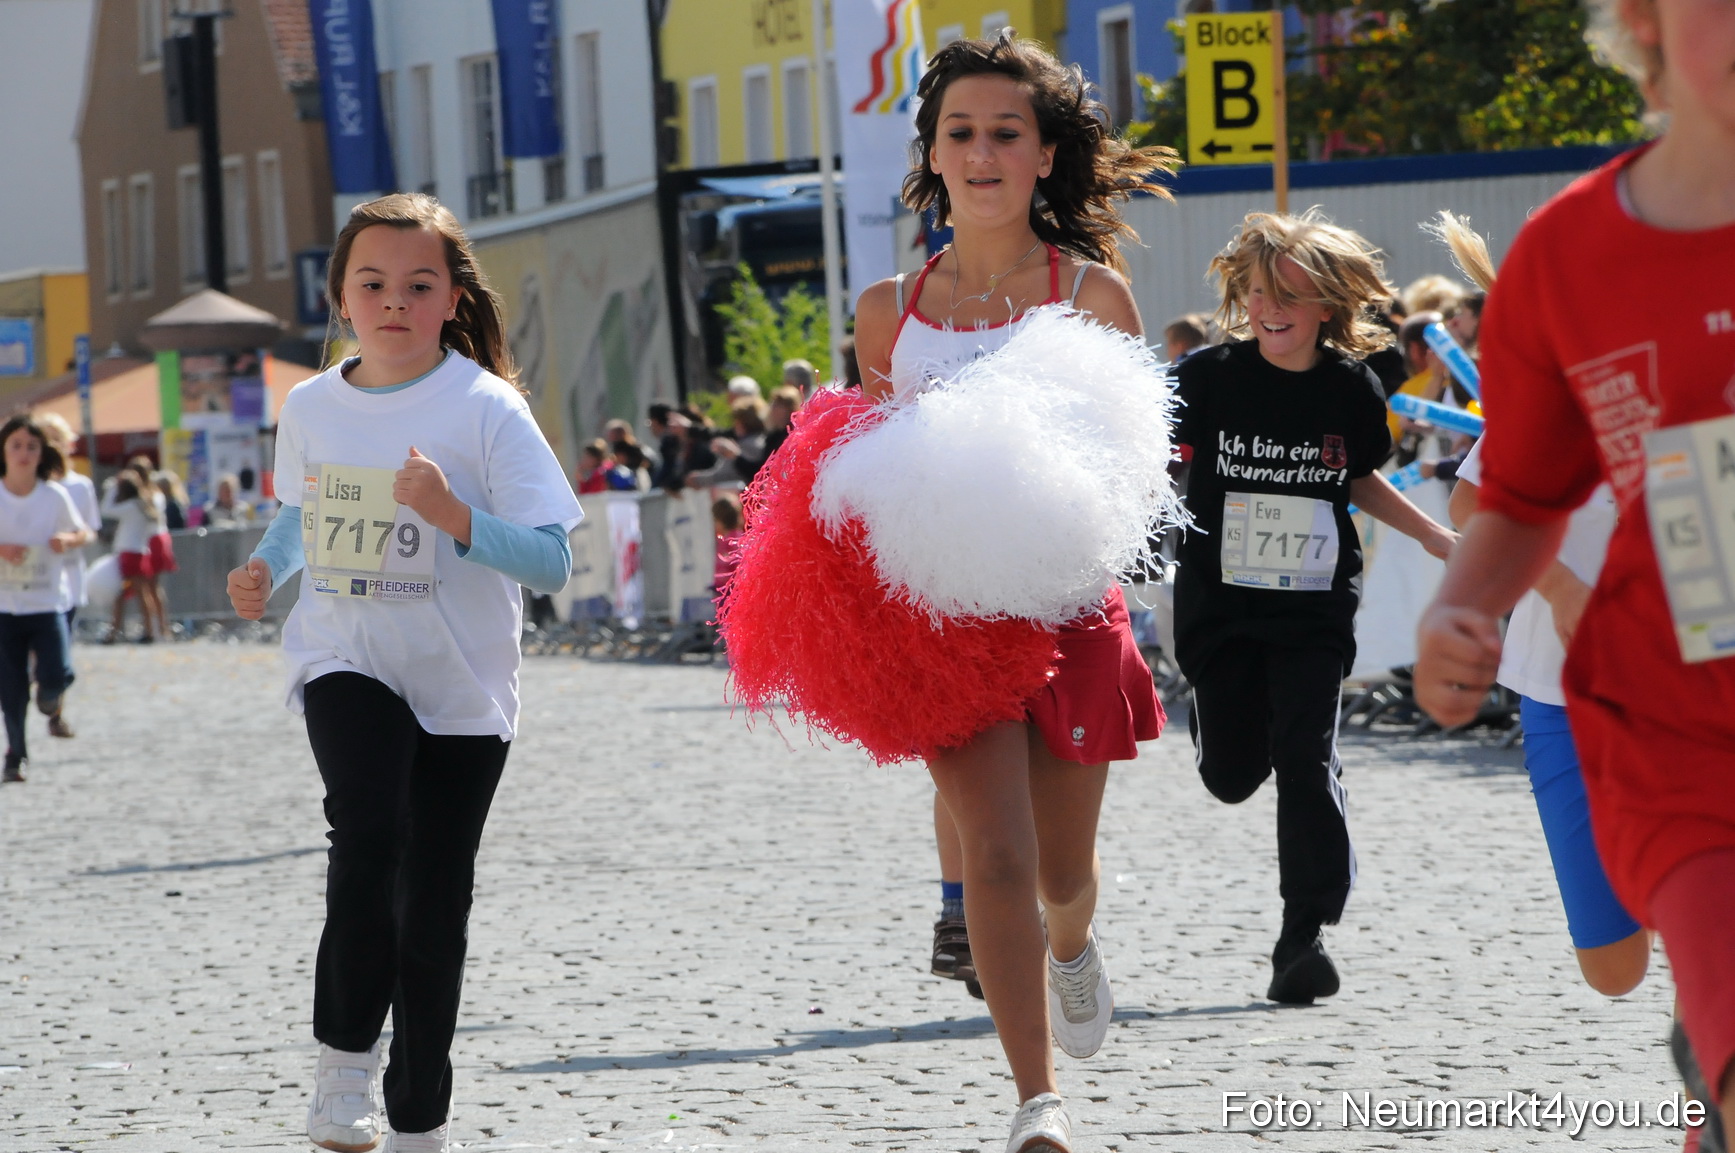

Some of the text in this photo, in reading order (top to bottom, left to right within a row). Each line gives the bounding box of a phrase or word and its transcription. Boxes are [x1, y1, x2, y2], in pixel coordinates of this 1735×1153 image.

[1197, 20, 1272, 47] Block
[1213, 60, 1259, 129] B
[1218, 430, 1320, 461] Ich bin ein
[1216, 453, 1348, 486] Neumarkter!
[325, 473, 362, 501] Lisa
[1255, 501, 1281, 520] Eva
[324, 516, 421, 559] 7179
[1256, 531, 1329, 560] 7177
[368, 580, 430, 593] PFLEIDERER
